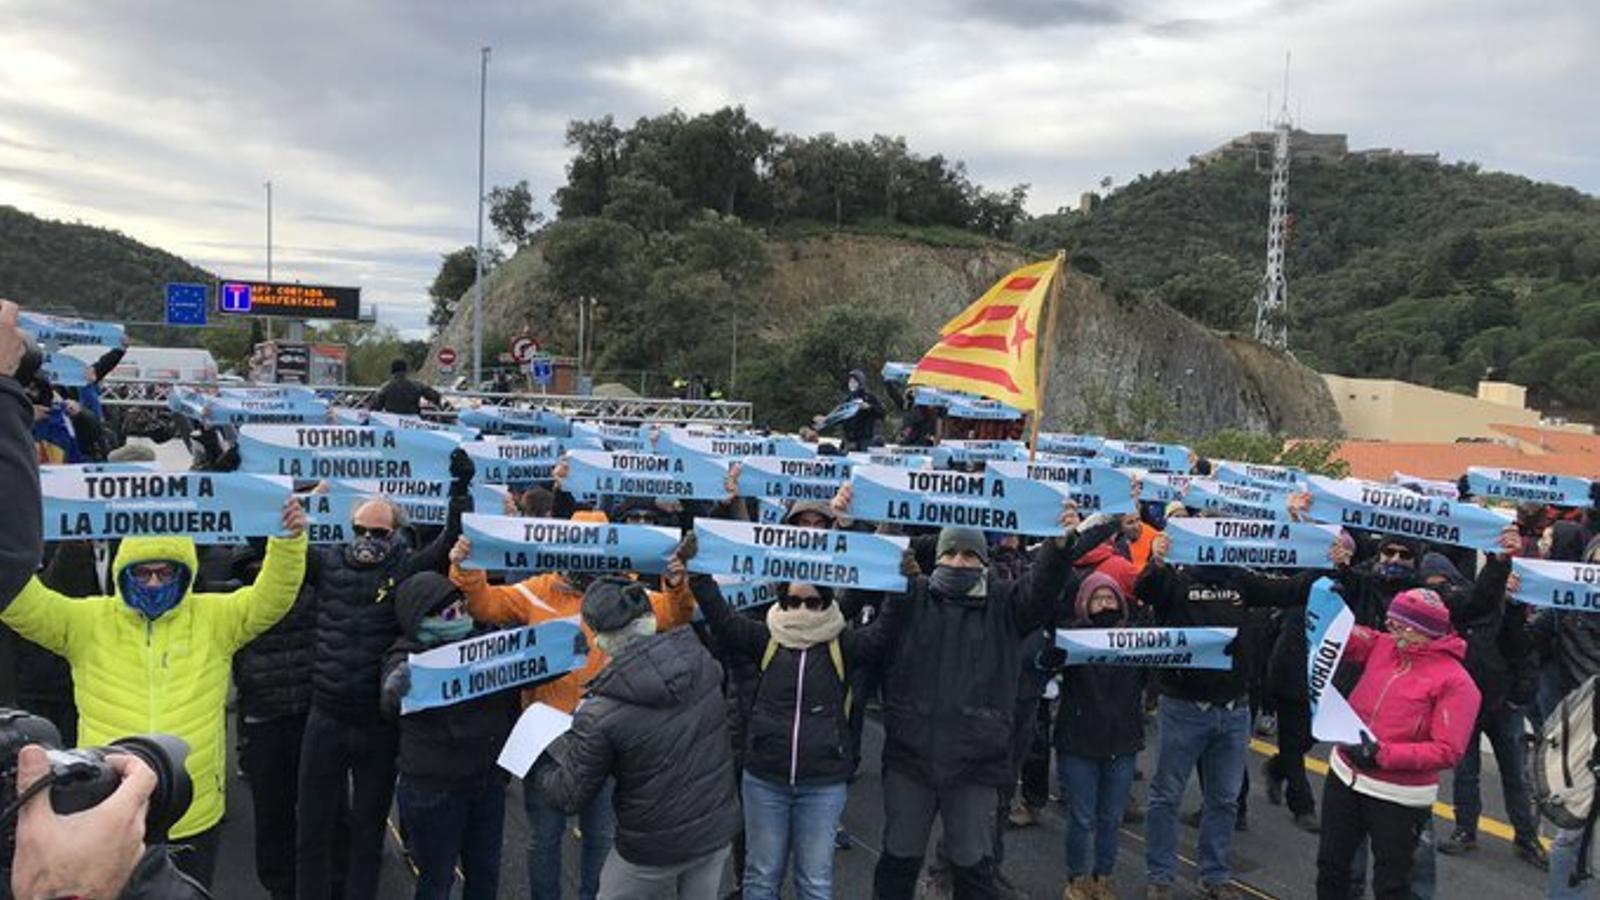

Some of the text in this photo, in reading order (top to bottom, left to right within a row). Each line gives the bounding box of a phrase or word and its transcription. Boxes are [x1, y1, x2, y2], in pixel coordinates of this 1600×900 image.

[297, 428, 396, 448] TOTHOM A
[498, 444, 551, 458] TOTHOM
[712, 440, 776, 456] TOTHOM A
[278, 458, 412, 478] LA JONQUERA
[485, 466, 502, 479] LA
[612, 454, 684, 473] TOTHOM A
[780, 460, 850, 478] TOTHOM A
[1027, 465, 1092, 485] TOTHOM A
[1500, 471, 1558, 486] TOTHOM A
[85, 476, 214, 499] TOTHOM A
[596, 476, 613, 492] LA
[618, 478, 694, 495] JONQUERA
[766, 482, 782, 496] LA
[908, 472, 1005, 498] TOTHOM A
[1488, 485, 1565, 502] LA JONQUERA
[1360, 488, 1431, 514] TOTHOM
[1437, 502, 1450, 517] A
[60, 510, 233, 536] LA JONQUERA
[888, 500, 910, 520] LA
[917, 502, 1018, 529] JONQUERA
[1215, 522, 1290, 539] TOTHOM A
[1342, 507, 1460, 542] LA JONQUERA
[524, 524, 619, 545] TOTHOM A
[753, 526, 848, 553] TOTHOM A
[504, 552, 633, 570] LA JONQUERA
[1197, 545, 1297, 564] LA JONQUERA
[731, 555, 860, 585] LA JONQUERA
[1553, 589, 1575, 606] LA
[458, 629, 537, 664] TOTHOM A
[1106, 631, 1187, 648] TOTHOM A
[441, 657, 549, 700] LA JONQUERA
